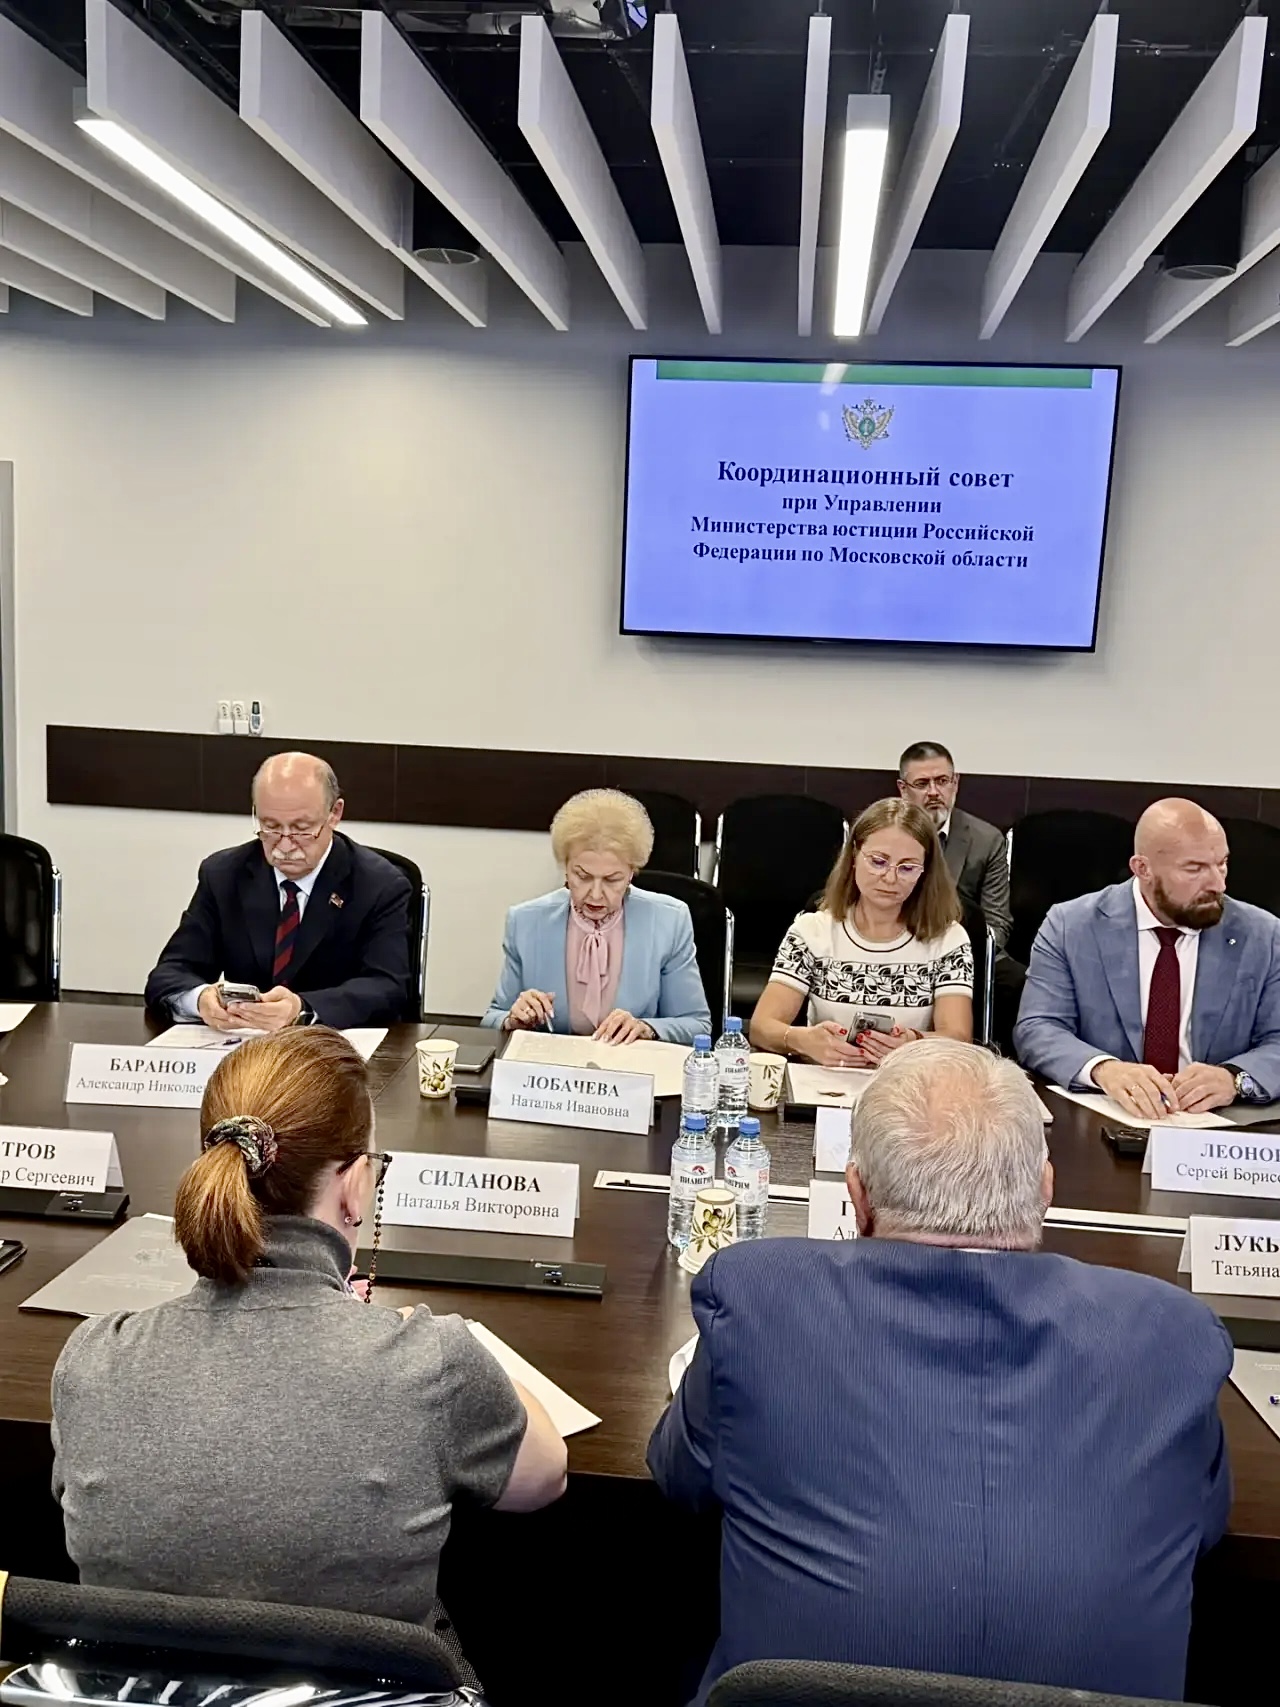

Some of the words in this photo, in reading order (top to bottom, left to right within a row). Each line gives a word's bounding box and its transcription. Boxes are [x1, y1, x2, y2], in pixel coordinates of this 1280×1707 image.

[717, 460, 940, 488] Координационный
[949, 472, 1015, 488] совет
[782, 497, 817, 514] при
[823, 494, 942, 516] Управлении
[690, 515, 828, 539] Министерства
[832, 524, 918, 540] юстиции
[921, 522, 1034, 542] Российской
[693, 542, 797, 564] Федерации
[801, 549, 824, 562] по
[829, 546, 946, 566] Московской
[951, 550, 1028, 568] области
[110, 1058, 197, 1075] БАРАНОВ
[75, 1076, 145, 1095] Александр
[148, 1079, 205, 1094] Николае
[522, 1075, 619, 1098] ЛОБАЧЕВА
[511, 1093, 563, 1111] Наталья
[566, 1099, 630, 1118] Ивановна
[13, 1167, 95, 1189] Сергеевич
[419, 1169, 541, 1193] СИЛАНОВА
[1176, 1163, 1228, 1181] Сергей
[1233, 1167, 1280, 1185] Борис
[396, 1192, 460, 1211] Наталья
[464, 1197, 559, 1219] Викторовна
[1214, 1234, 1280, 1253] ЛУКЬ
[1211, 1259, 1280, 1278] Татьяна
